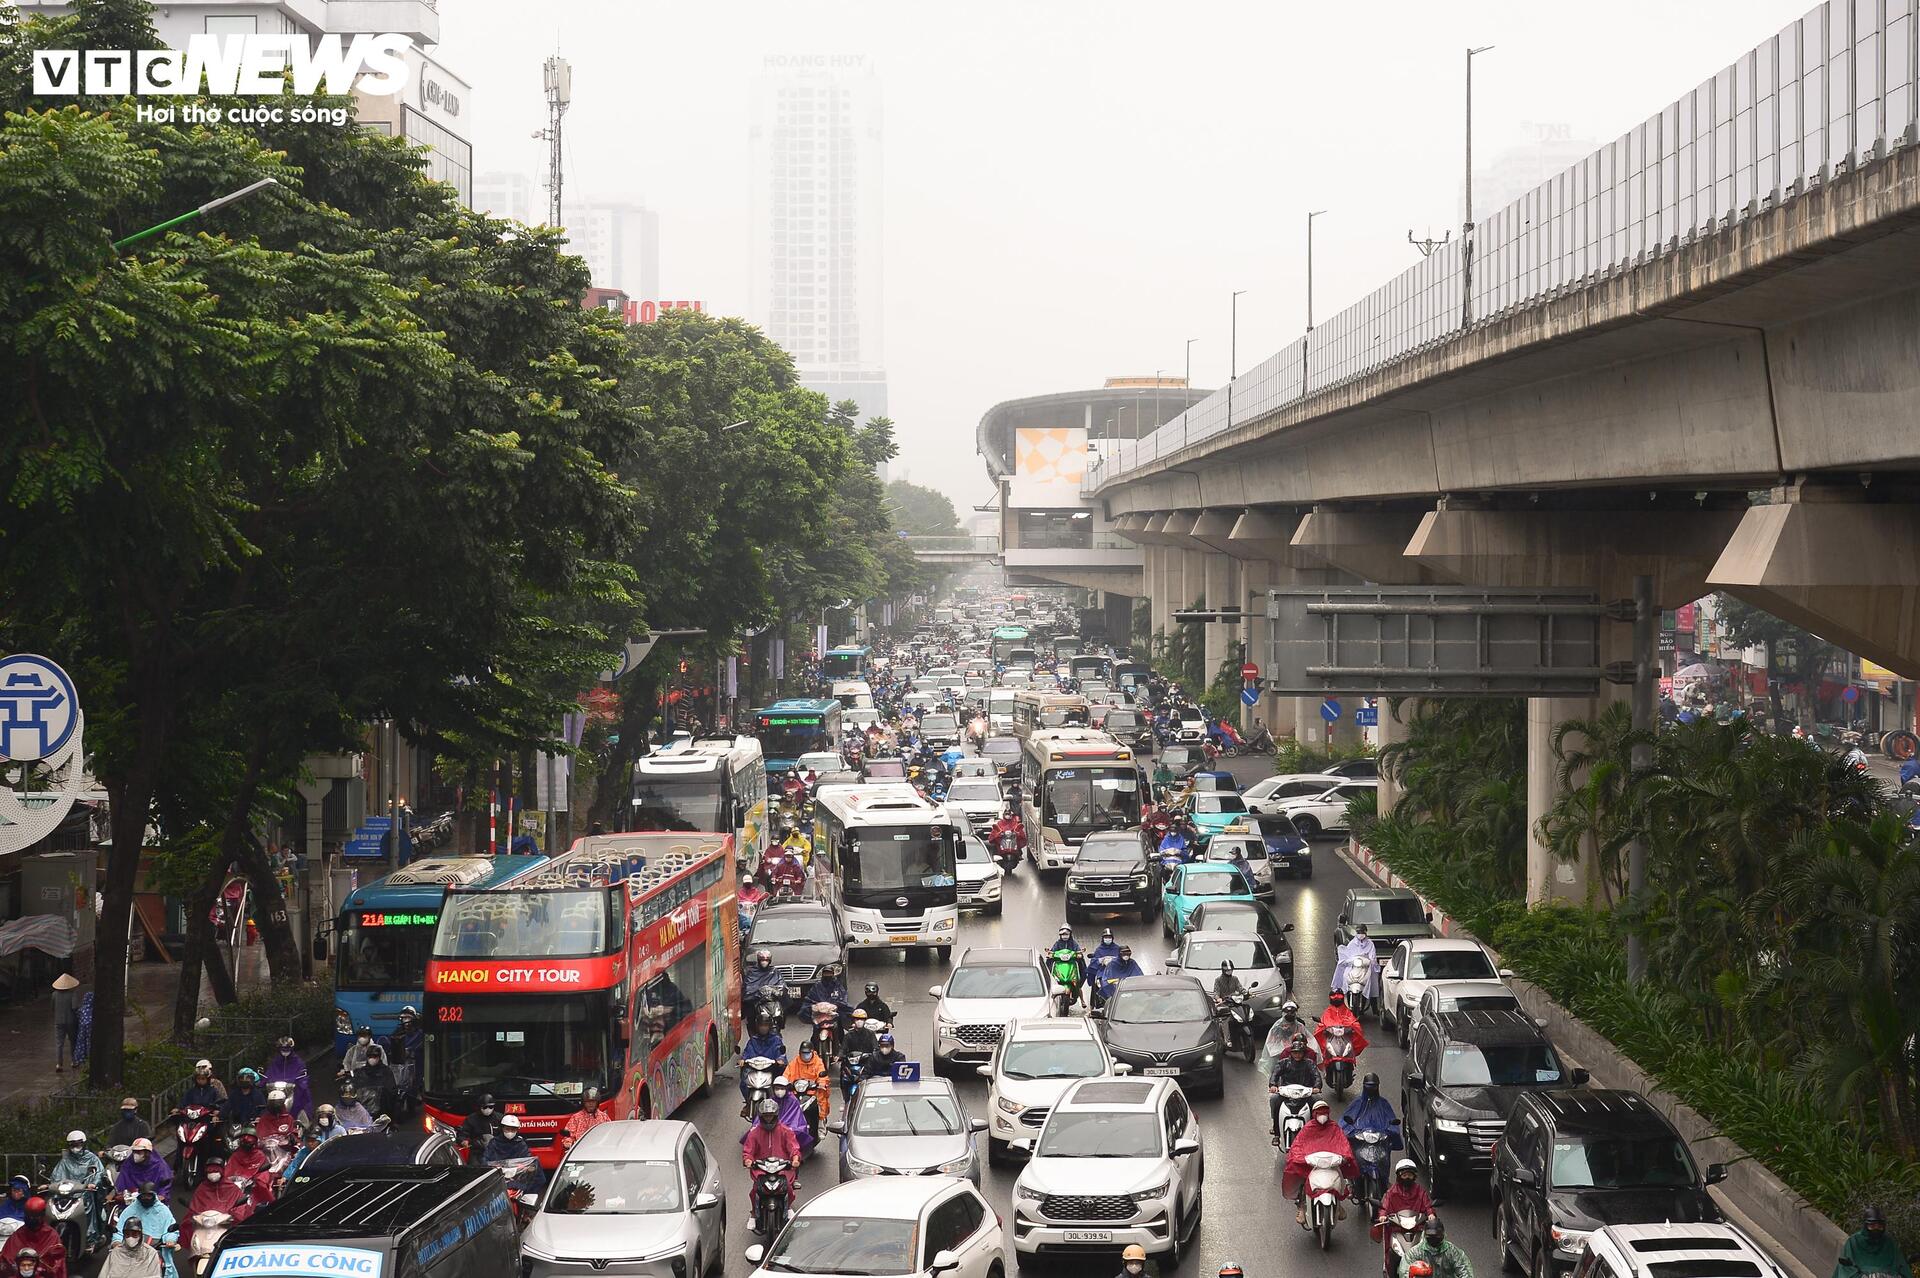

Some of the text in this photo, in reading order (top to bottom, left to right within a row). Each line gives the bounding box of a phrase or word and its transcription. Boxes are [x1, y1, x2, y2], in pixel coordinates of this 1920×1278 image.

[831, 54, 865, 67] HUY
[362, 914, 384, 926] 21A
[437, 969, 580, 983] HANOI CITY TOUR
[1067, 1231, 1109, 1241] 30L-939.94
[223, 1251, 373, 1273] HOÀNG CÔNG
